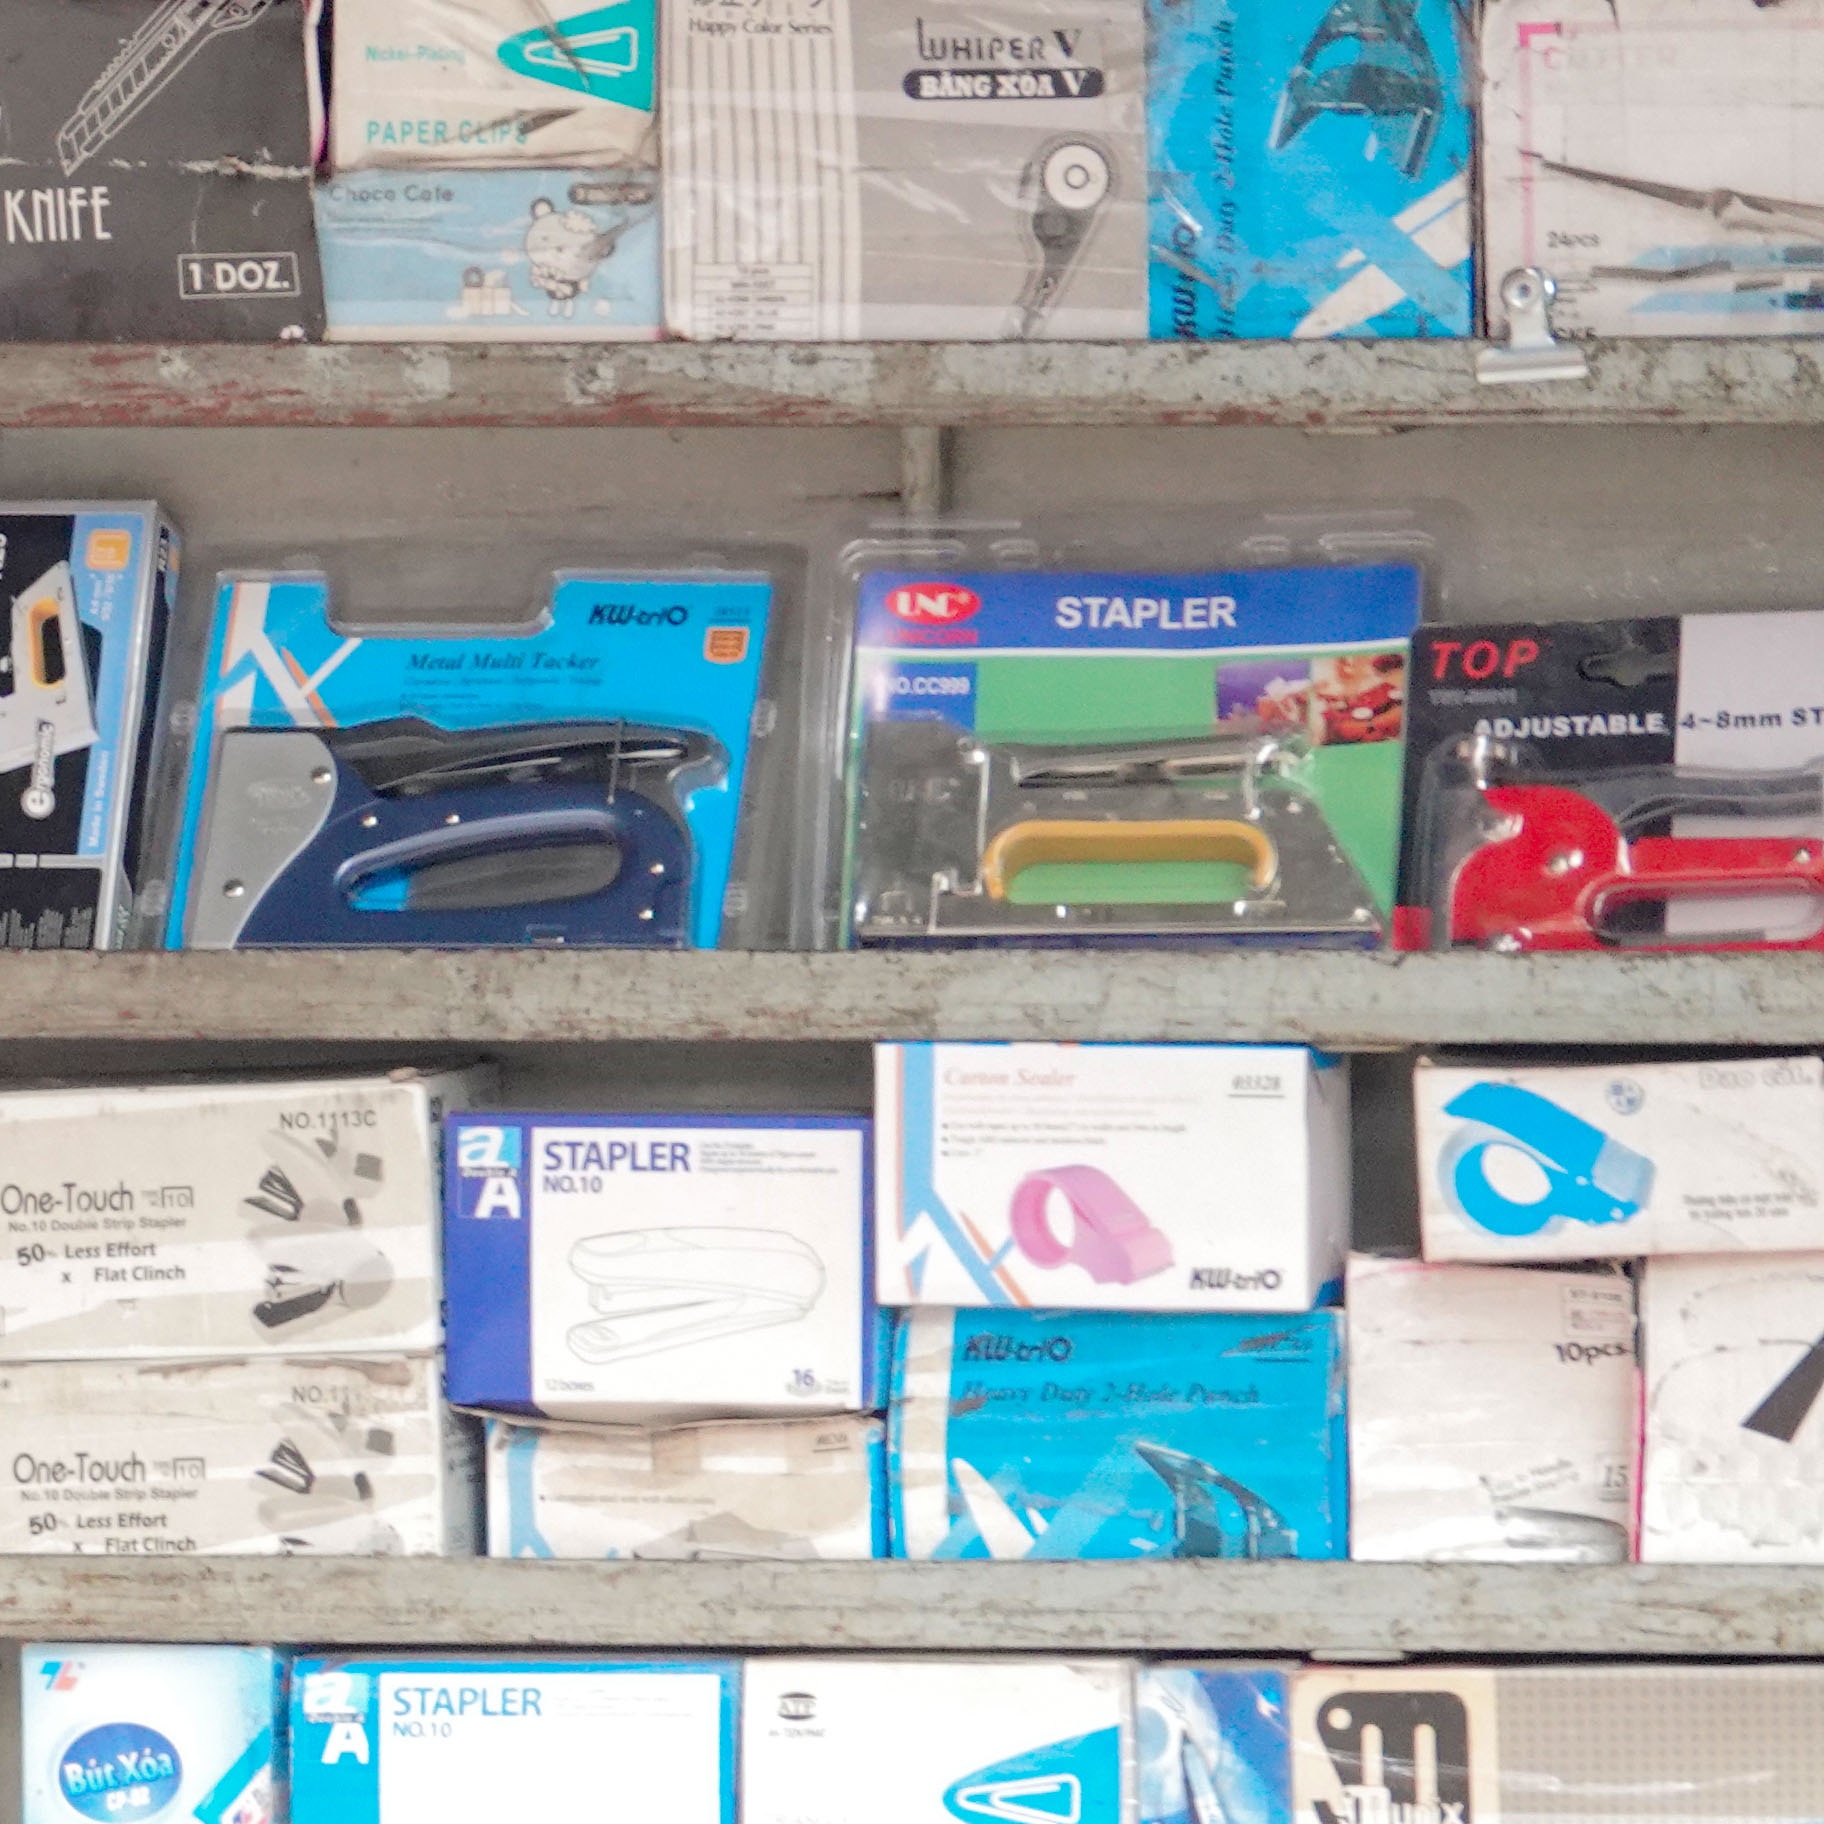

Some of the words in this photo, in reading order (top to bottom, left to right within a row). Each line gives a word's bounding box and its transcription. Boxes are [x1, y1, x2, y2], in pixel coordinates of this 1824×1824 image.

[366, 119, 449, 146] PAPER
[5, 186, 112, 244] KNIFE
[188, 263, 204, 292] 1
[215, 260, 290, 293] DOZ.
[1056, 596, 1237, 630] STAPLER
[1429, 639, 1540, 682] TOP
[1473, 712, 1665, 738] ADJUSTABLE
[543, 1141, 690, 1172] STAPLER
[0, 1182, 135, 1215] One-Touch
[543, 1176, 603, 1193] NO.10
[65, 1243, 100, 1259] Less
[107, 1243, 156, 1258] Effort
[94, 1266, 125, 1282] Flat
[133, 1265, 185, 1281] Clinch
[1189, 1266, 1283, 1292] KW-triO
[13, 1452, 146, 1485] One-Touch
[77, 1514, 112, 1529] Less
[118, 1513, 167, 1528] Effort
[392, 1686, 543, 1719] STAPLER
[392, 1721, 453, 1740] NO.10
[64, 1757, 117, 1796] Bút
[118, 1748, 174, 1781] Xóa
